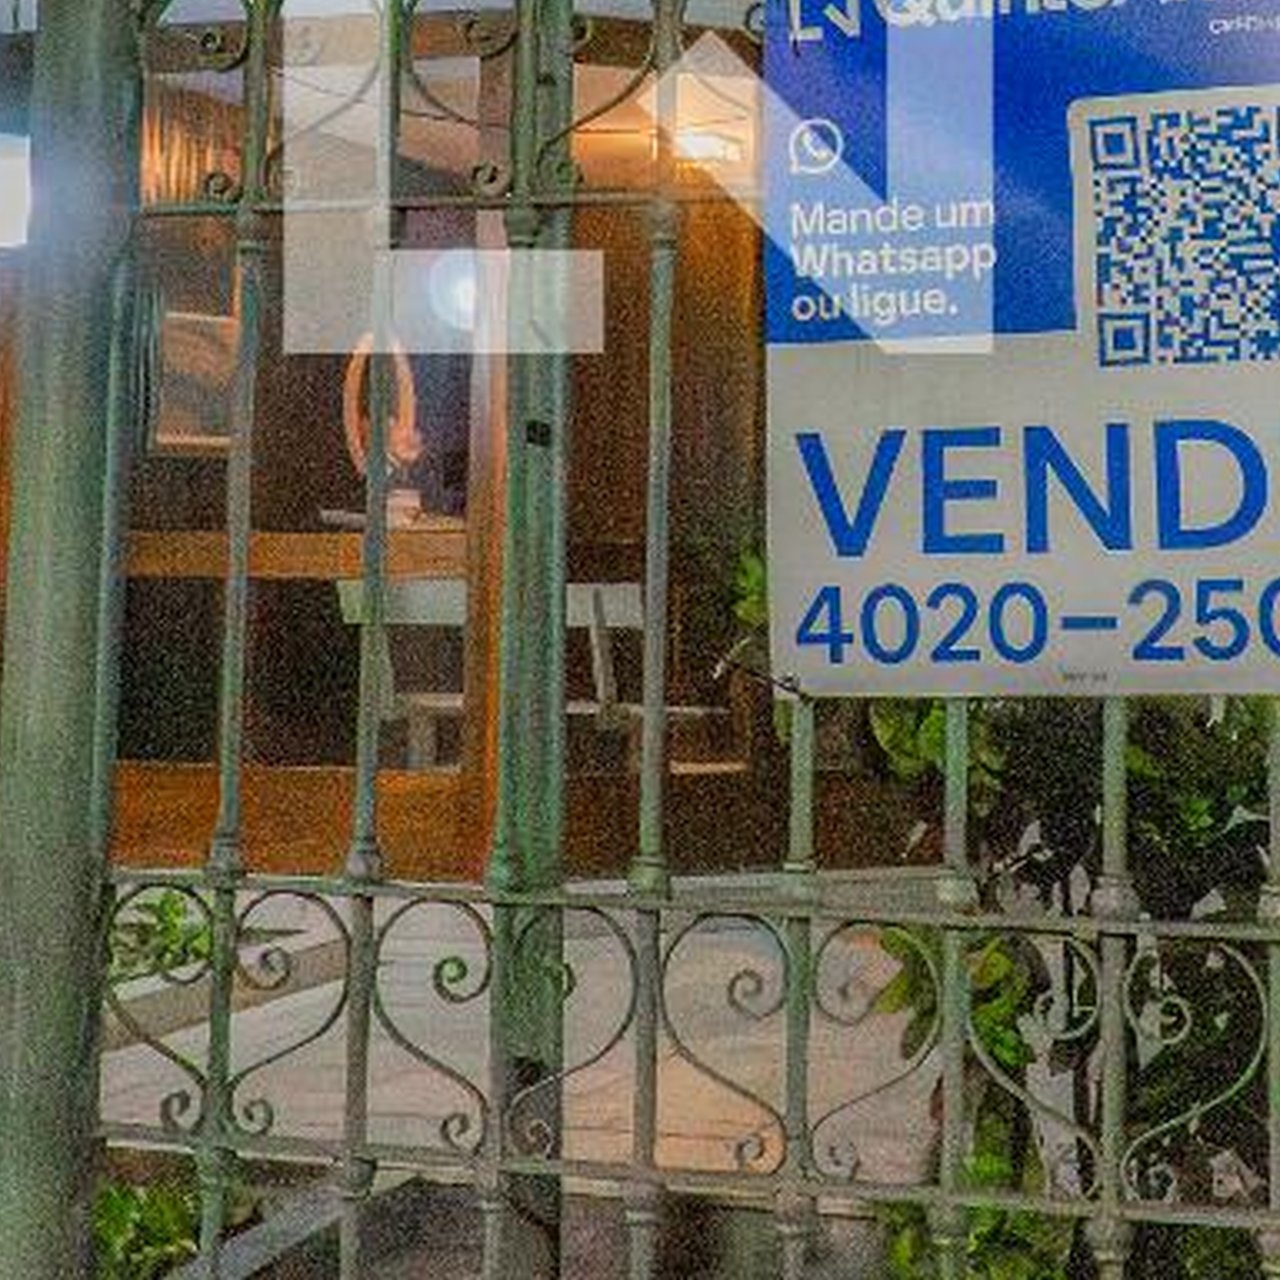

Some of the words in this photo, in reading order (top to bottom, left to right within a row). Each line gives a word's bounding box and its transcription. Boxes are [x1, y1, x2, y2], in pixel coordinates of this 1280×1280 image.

[790, 197, 924, 239] Mande
[935, 199, 996, 228] um
[790, 242, 997, 281] Whatsapp
[792, 293, 841, 321] ou
[851, 283, 959, 326] ligue.
